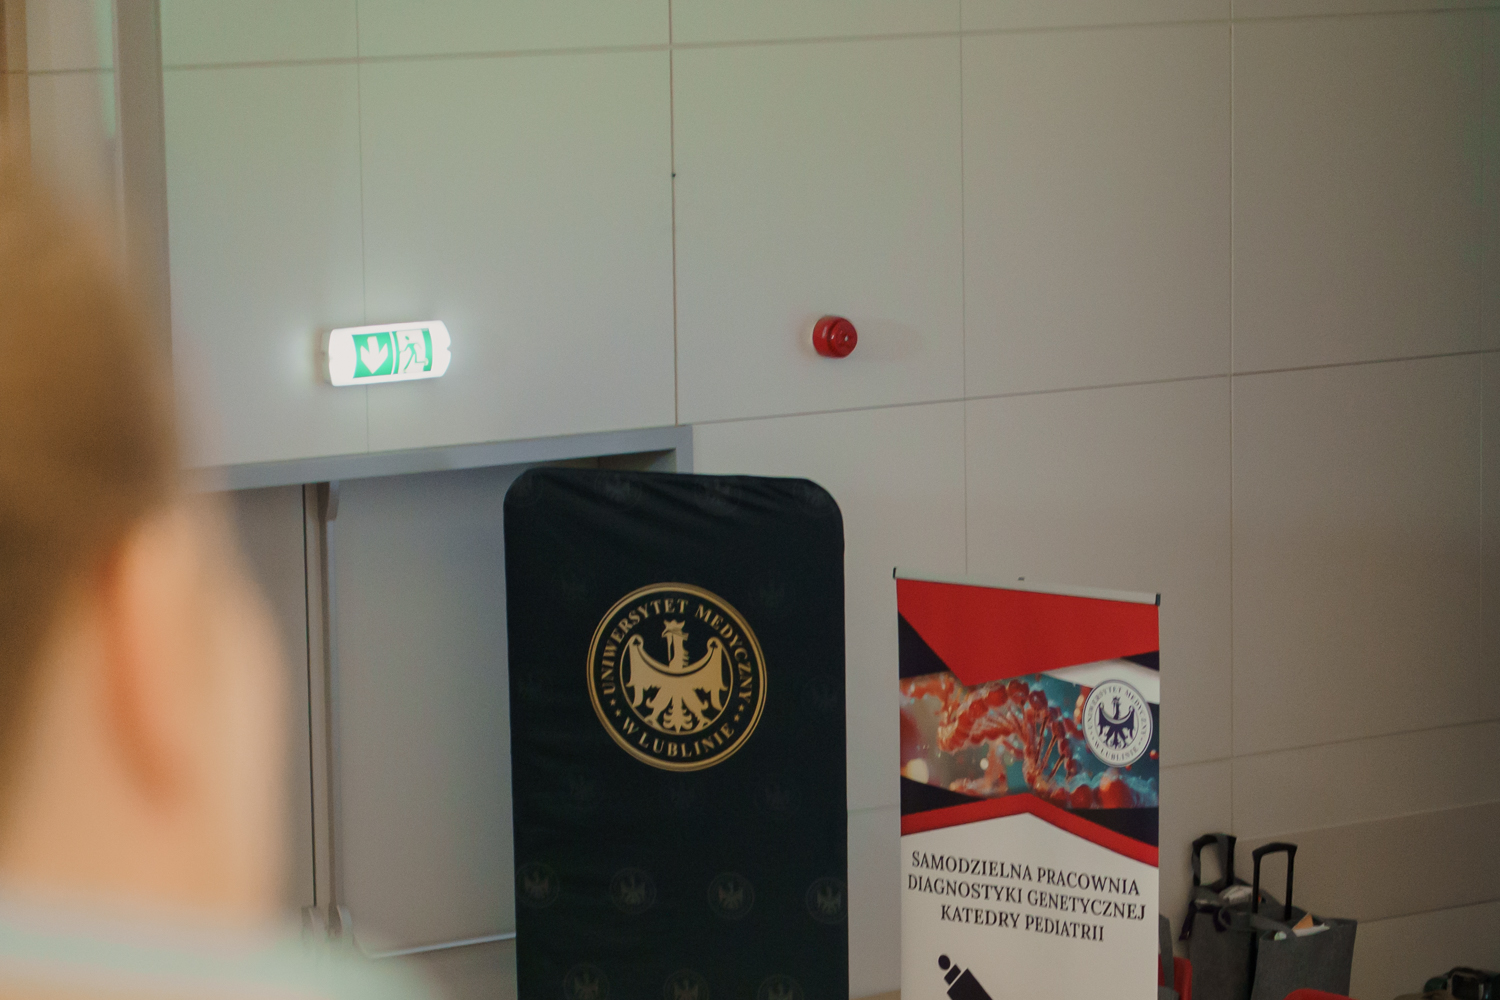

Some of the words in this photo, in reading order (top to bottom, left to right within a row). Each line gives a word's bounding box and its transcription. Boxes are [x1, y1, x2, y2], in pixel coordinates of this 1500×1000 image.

[602, 598, 689, 696] UNIWERSYTET
[695, 604, 753, 704] MEDYCZNY
[621, 716, 639, 735] W
[638, 722, 735, 758] LUBLINIE
[911, 850, 1032, 882] SAMODZIELNA
[1037, 866, 1140, 896] PRACOWNIA
[907, 873, 1022, 904] DIAGNOSTYKI
[1027, 889, 1146, 921] GENETYCZNEJ
[940, 904, 1020, 929] KATEDRY
[1025, 914, 1104, 942] PEDIATRII
